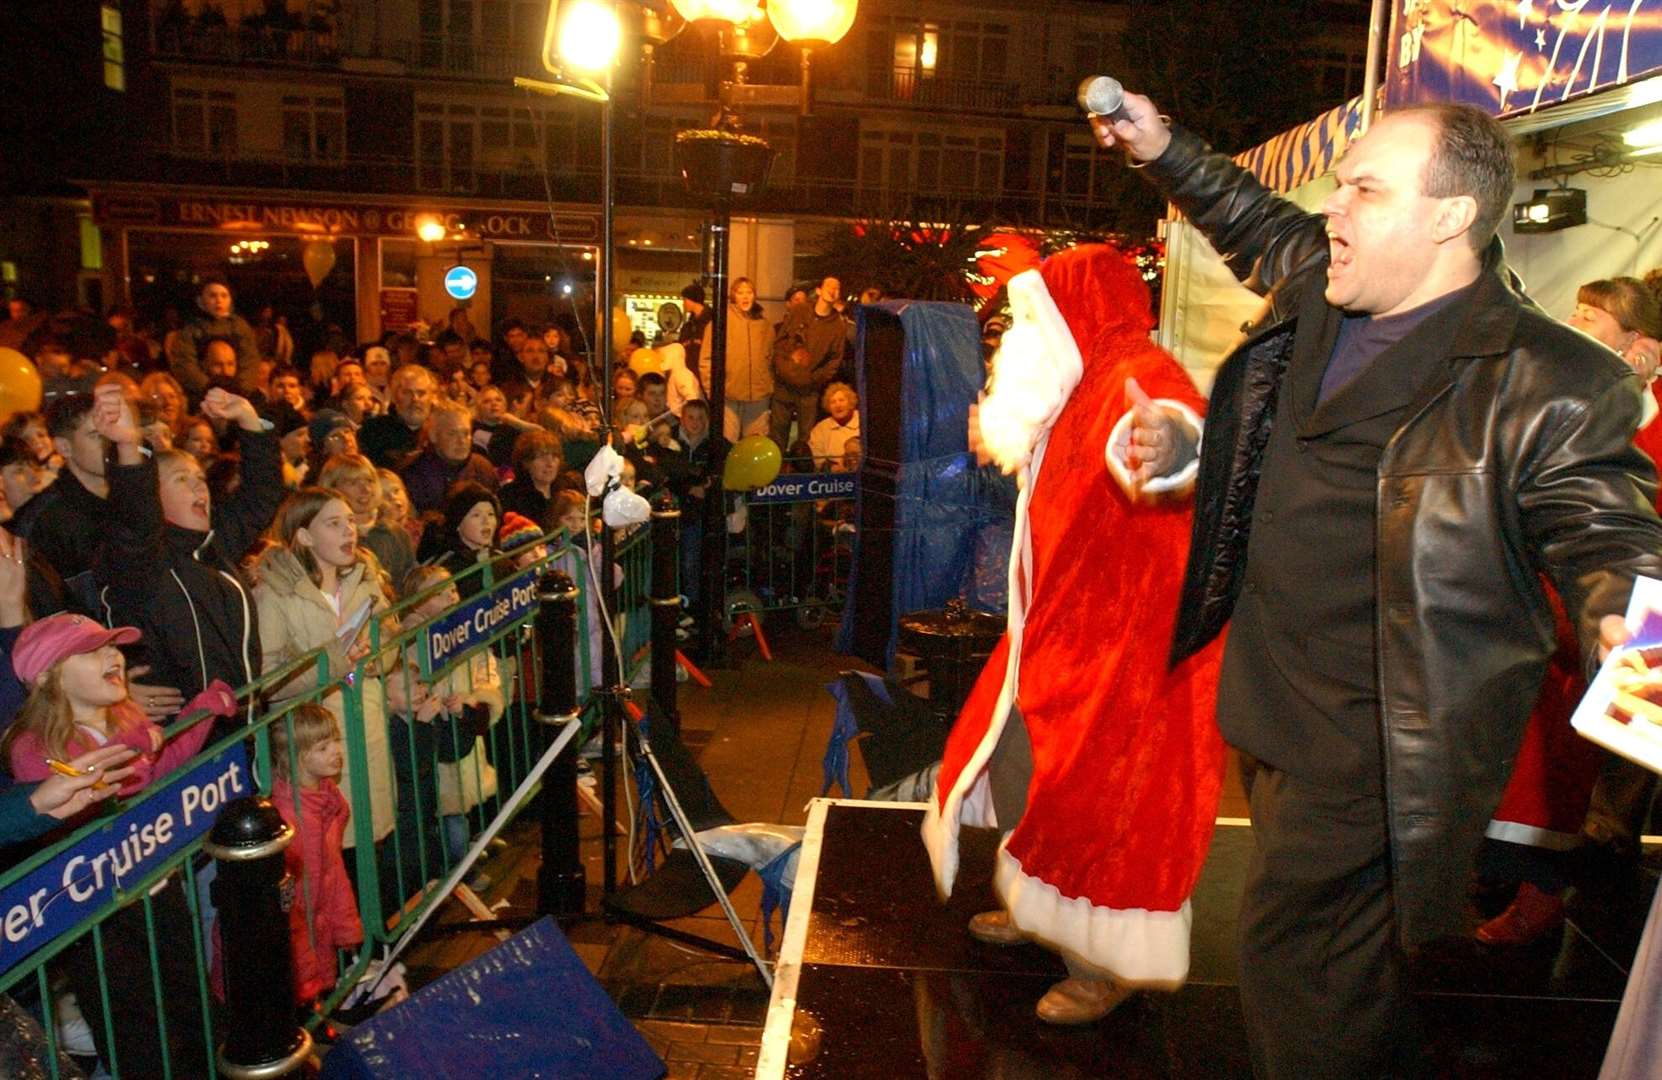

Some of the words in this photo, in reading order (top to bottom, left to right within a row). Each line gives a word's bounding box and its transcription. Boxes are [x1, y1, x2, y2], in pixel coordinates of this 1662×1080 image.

[180, 202, 259, 222] ERNEST
[263, 206, 358, 227] NEWSON
[807, 480, 854, 494] Cruise
[432, 620, 471, 659] Dover
[474, 598, 511, 633] Cruise
[512, 581, 537, 610] Port
[0, 887, 47, 943] er
[62, 812, 174, 903] Cruise
[181, 761, 243, 826] Port
